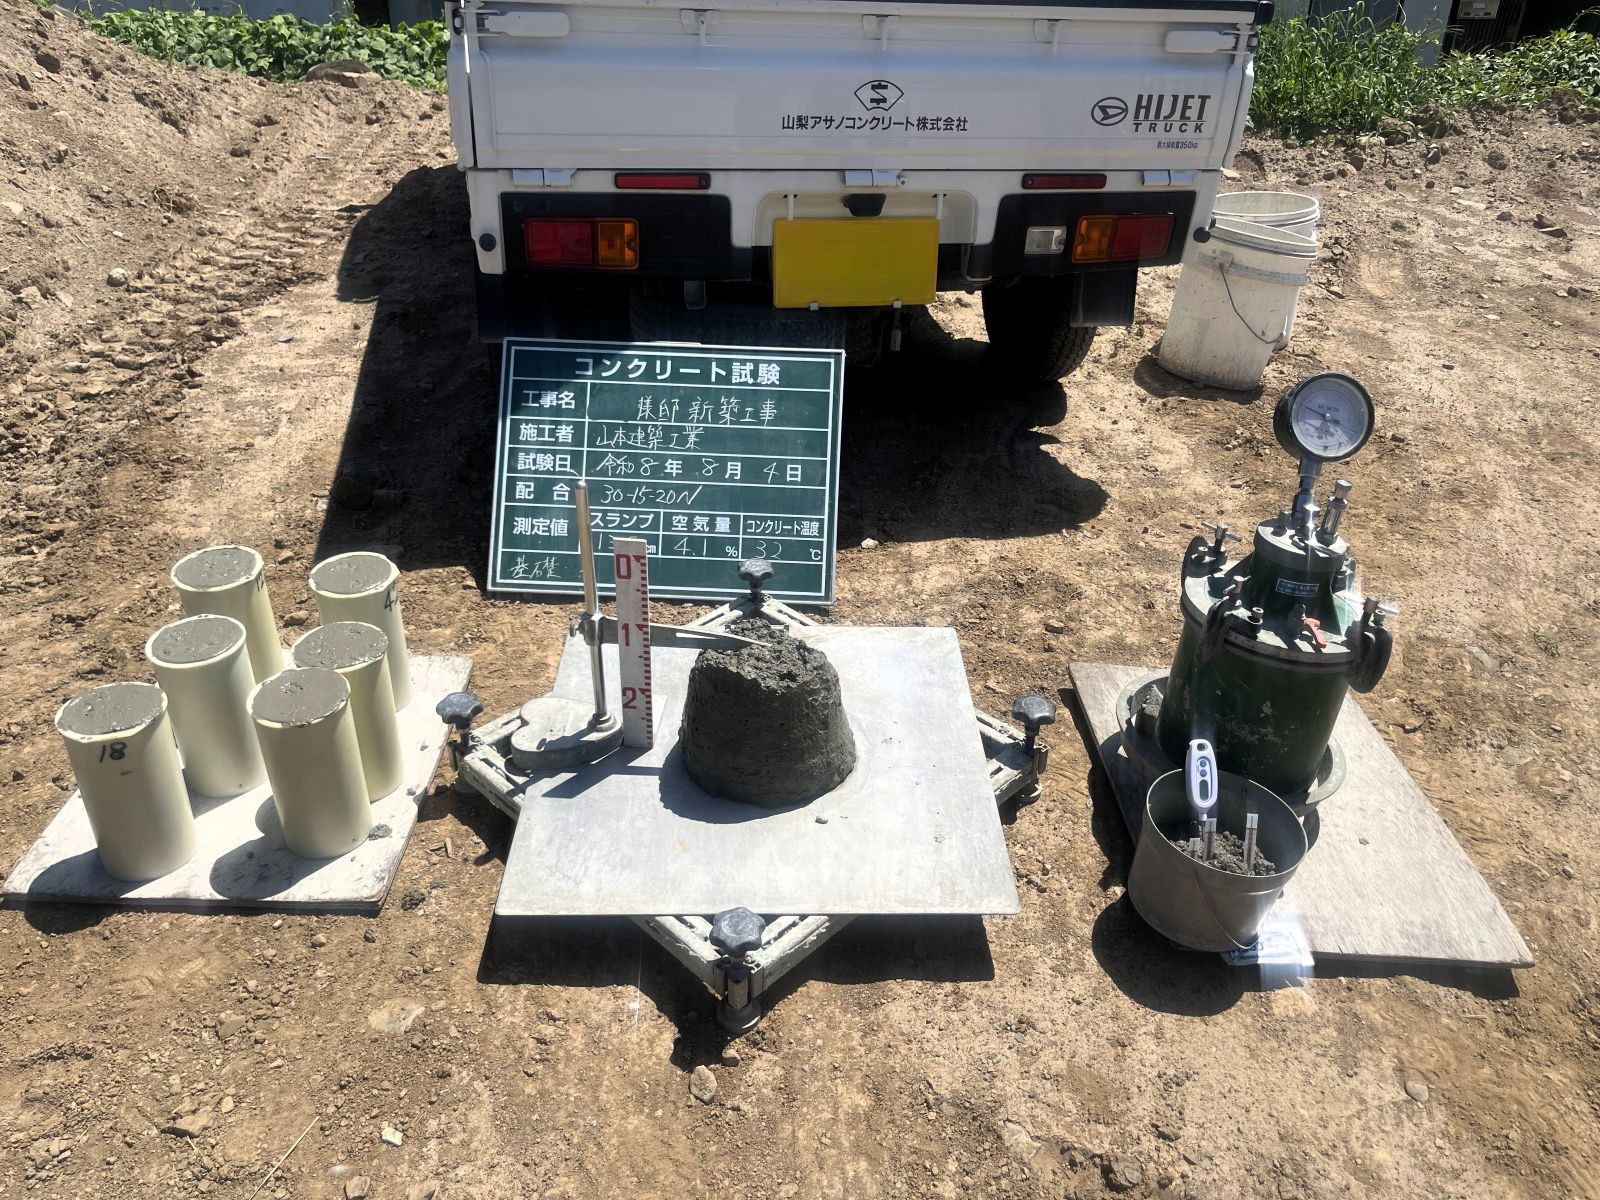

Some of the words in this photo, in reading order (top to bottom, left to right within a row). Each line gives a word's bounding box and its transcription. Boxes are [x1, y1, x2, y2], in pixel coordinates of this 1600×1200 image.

[1133, 94, 1211, 120] HIJET
[782, 115, 968, 131] 山梨アサノコンクリート株式会社
[1133, 122, 1204, 133] TRUCK
[575, 358, 780, 385] コンクリート試験
[521, 390, 575, 409] 工事名
[519, 423, 574, 443] 施工者
[517, 453, 571, 471] 試験日
[515, 482, 571, 501] 配合
[513, 517, 568, 536] 測定値
[590, 512, 654, 528] スランプ
[671, 515, 731, 533] 空気量
[747, 520, 819, 536] コンクリート温度
[673, 537, 707, 556] 4.1
[725, 545, 738, 557] %
[755, 540, 781, 559] 32
[510, 554, 560, 579] 基礎
[615, 553, 631, 580] 0
[621, 622, 630, 646] 1
[622, 686, 637, 709] 2
[100, 741, 127, 763] 18
